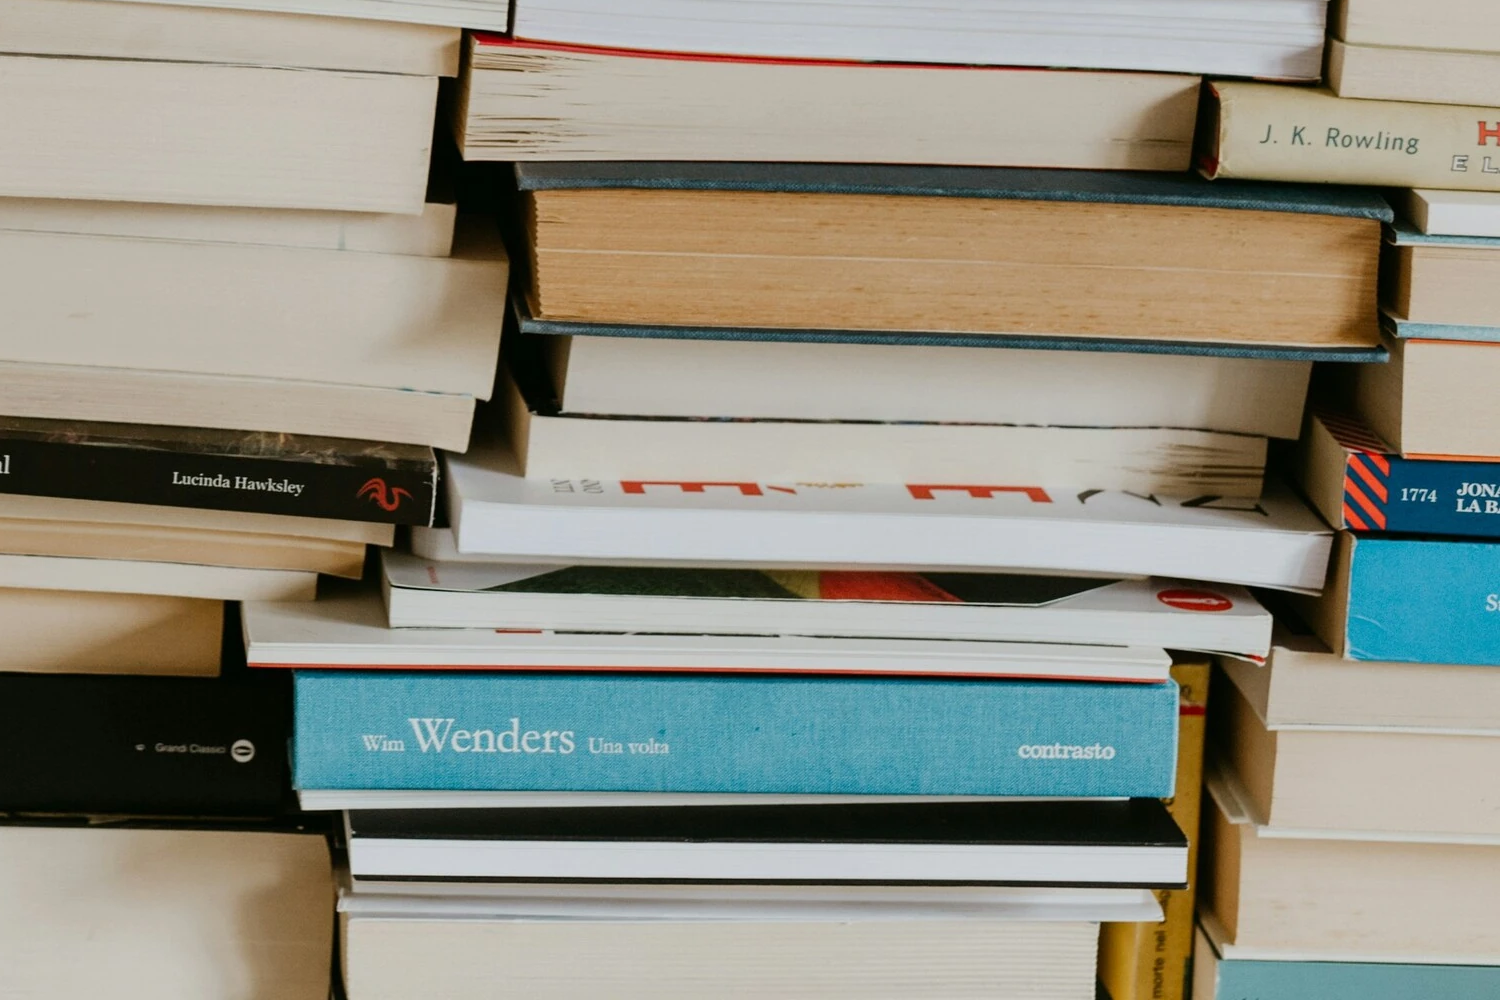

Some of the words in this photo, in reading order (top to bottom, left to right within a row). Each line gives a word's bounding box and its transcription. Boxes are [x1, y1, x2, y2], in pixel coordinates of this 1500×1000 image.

[1259, 124, 1277, 144] J.
[1291, 126, 1311, 146] K.
[1325, 127, 1419, 154] Rowling
[1451, 154, 1469, 172] E
[172, 471, 230, 488] Lucinda
[234, 476, 304, 497] Hawksley
[1401, 487, 1438, 503] 1774
[1456, 498, 1481, 513] LA
[1485, 500, 1500, 514] B
[362, 735, 404, 752] Wim
[408, 717, 575, 754] Wenders
[588, 737, 623, 754] Una
[628, 737, 669, 755] volta
[1017, 742, 1116, 760] contrasto
[1152, 957, 1165, 999] morte
